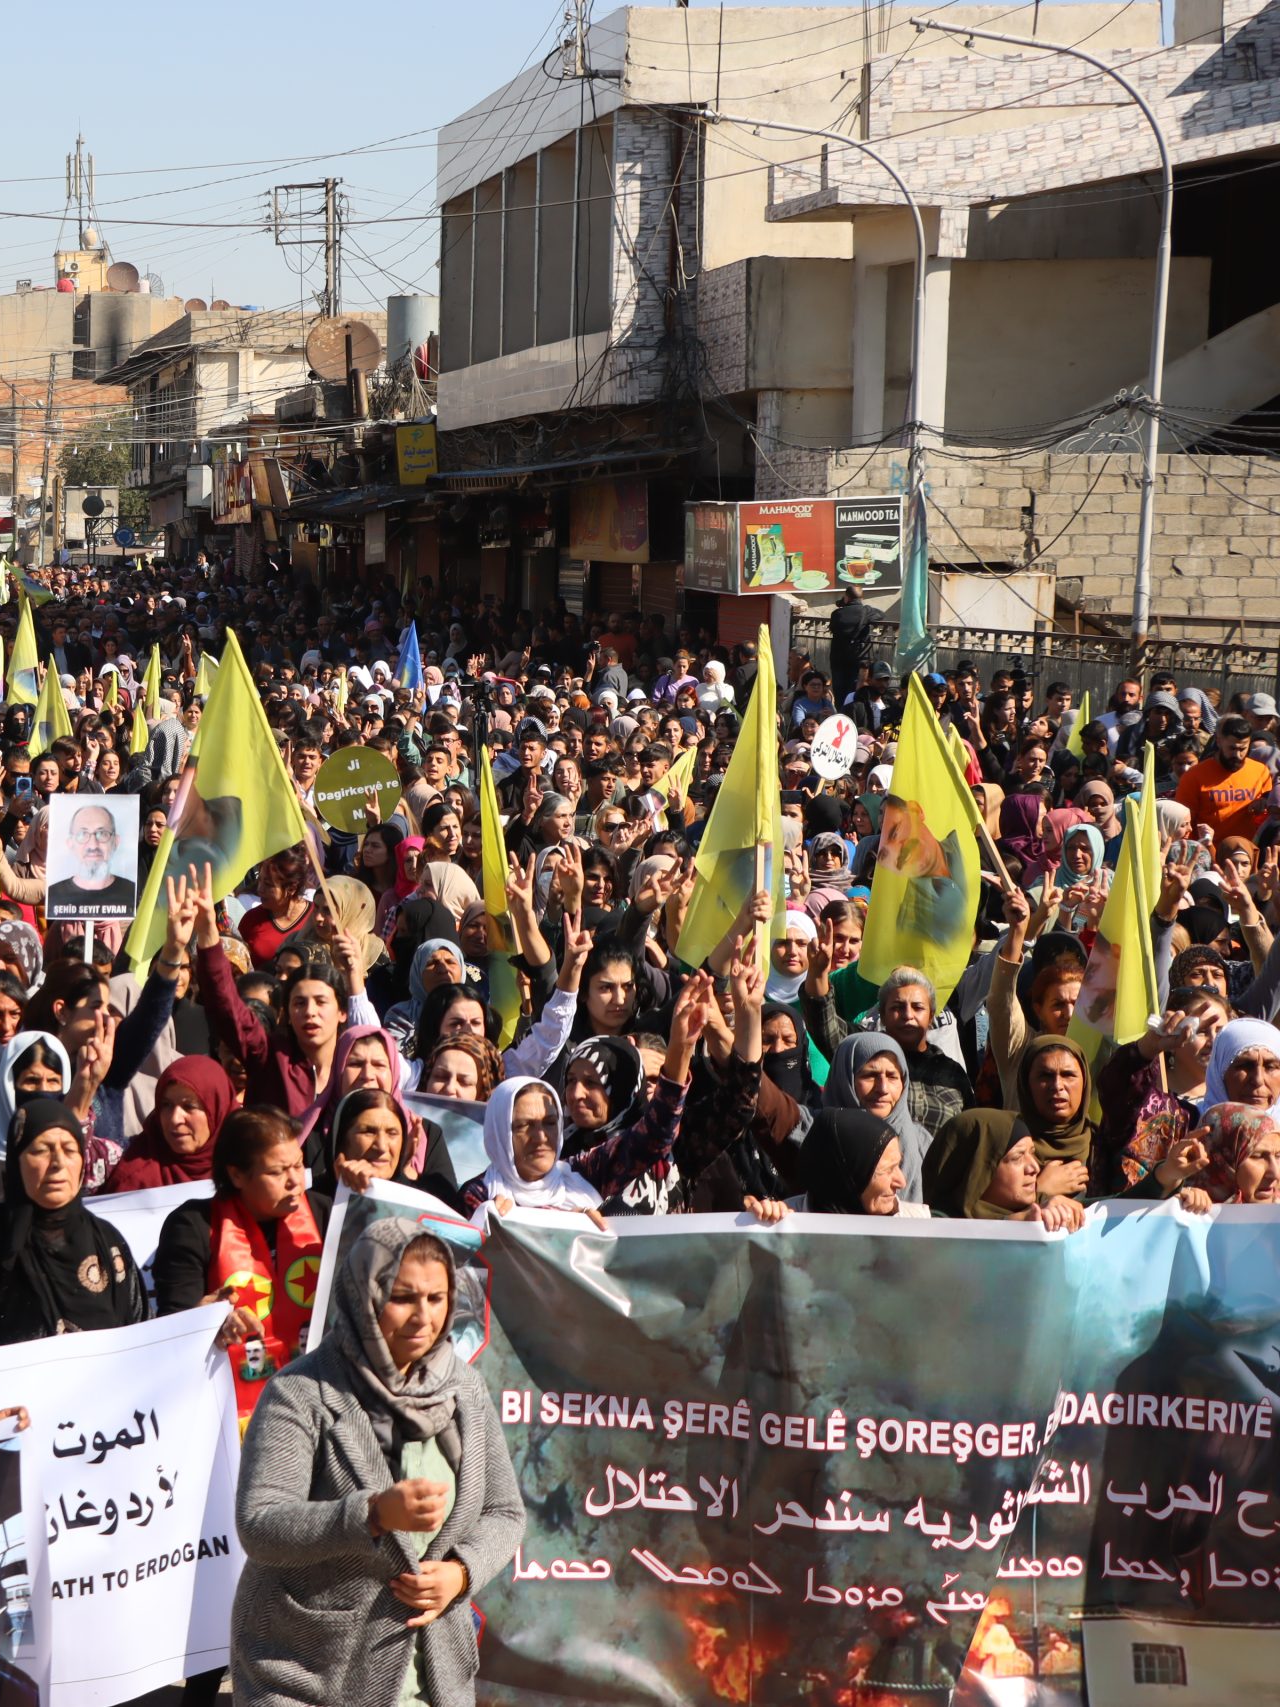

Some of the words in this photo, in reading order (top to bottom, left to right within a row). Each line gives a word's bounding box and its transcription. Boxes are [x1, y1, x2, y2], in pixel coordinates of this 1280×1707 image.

[759, 504, 812, 515] MAHMOOD
[839, 509, 884, 522] MAHMOOD
[885, 509, 900, 521] TEA
[347, 758, 361, 771] Ji
[317, 780, 383, 802] Dagirkeryê
[386, 780, 399, 788] re
[352, 808, 367, 820] N
[101, 905, 127, 914] EVRAN
[52, 1407, 160, 1464] الموت
[501, 1390, 532, 1424] BI
[540, 1390, 654, 1431] SEKNA
[662, 1398, 751, 1440] ŞERÊ
[759, 1408, 847, 1452] GELÊ
[1061, 1391, 1273, 1439] DAGIRKERIYÊ
[585, 1463, 740, 1518] الاحتلال
[1106, 1469, 1224, 1521] الحرب
[754, 1490, 892, 1536] سندحر
[51, 1575, 95, 1600] ATH
[102, 1568, 130, 1592] TO
[135, 1534, 231, 1582] ERDOGAN
